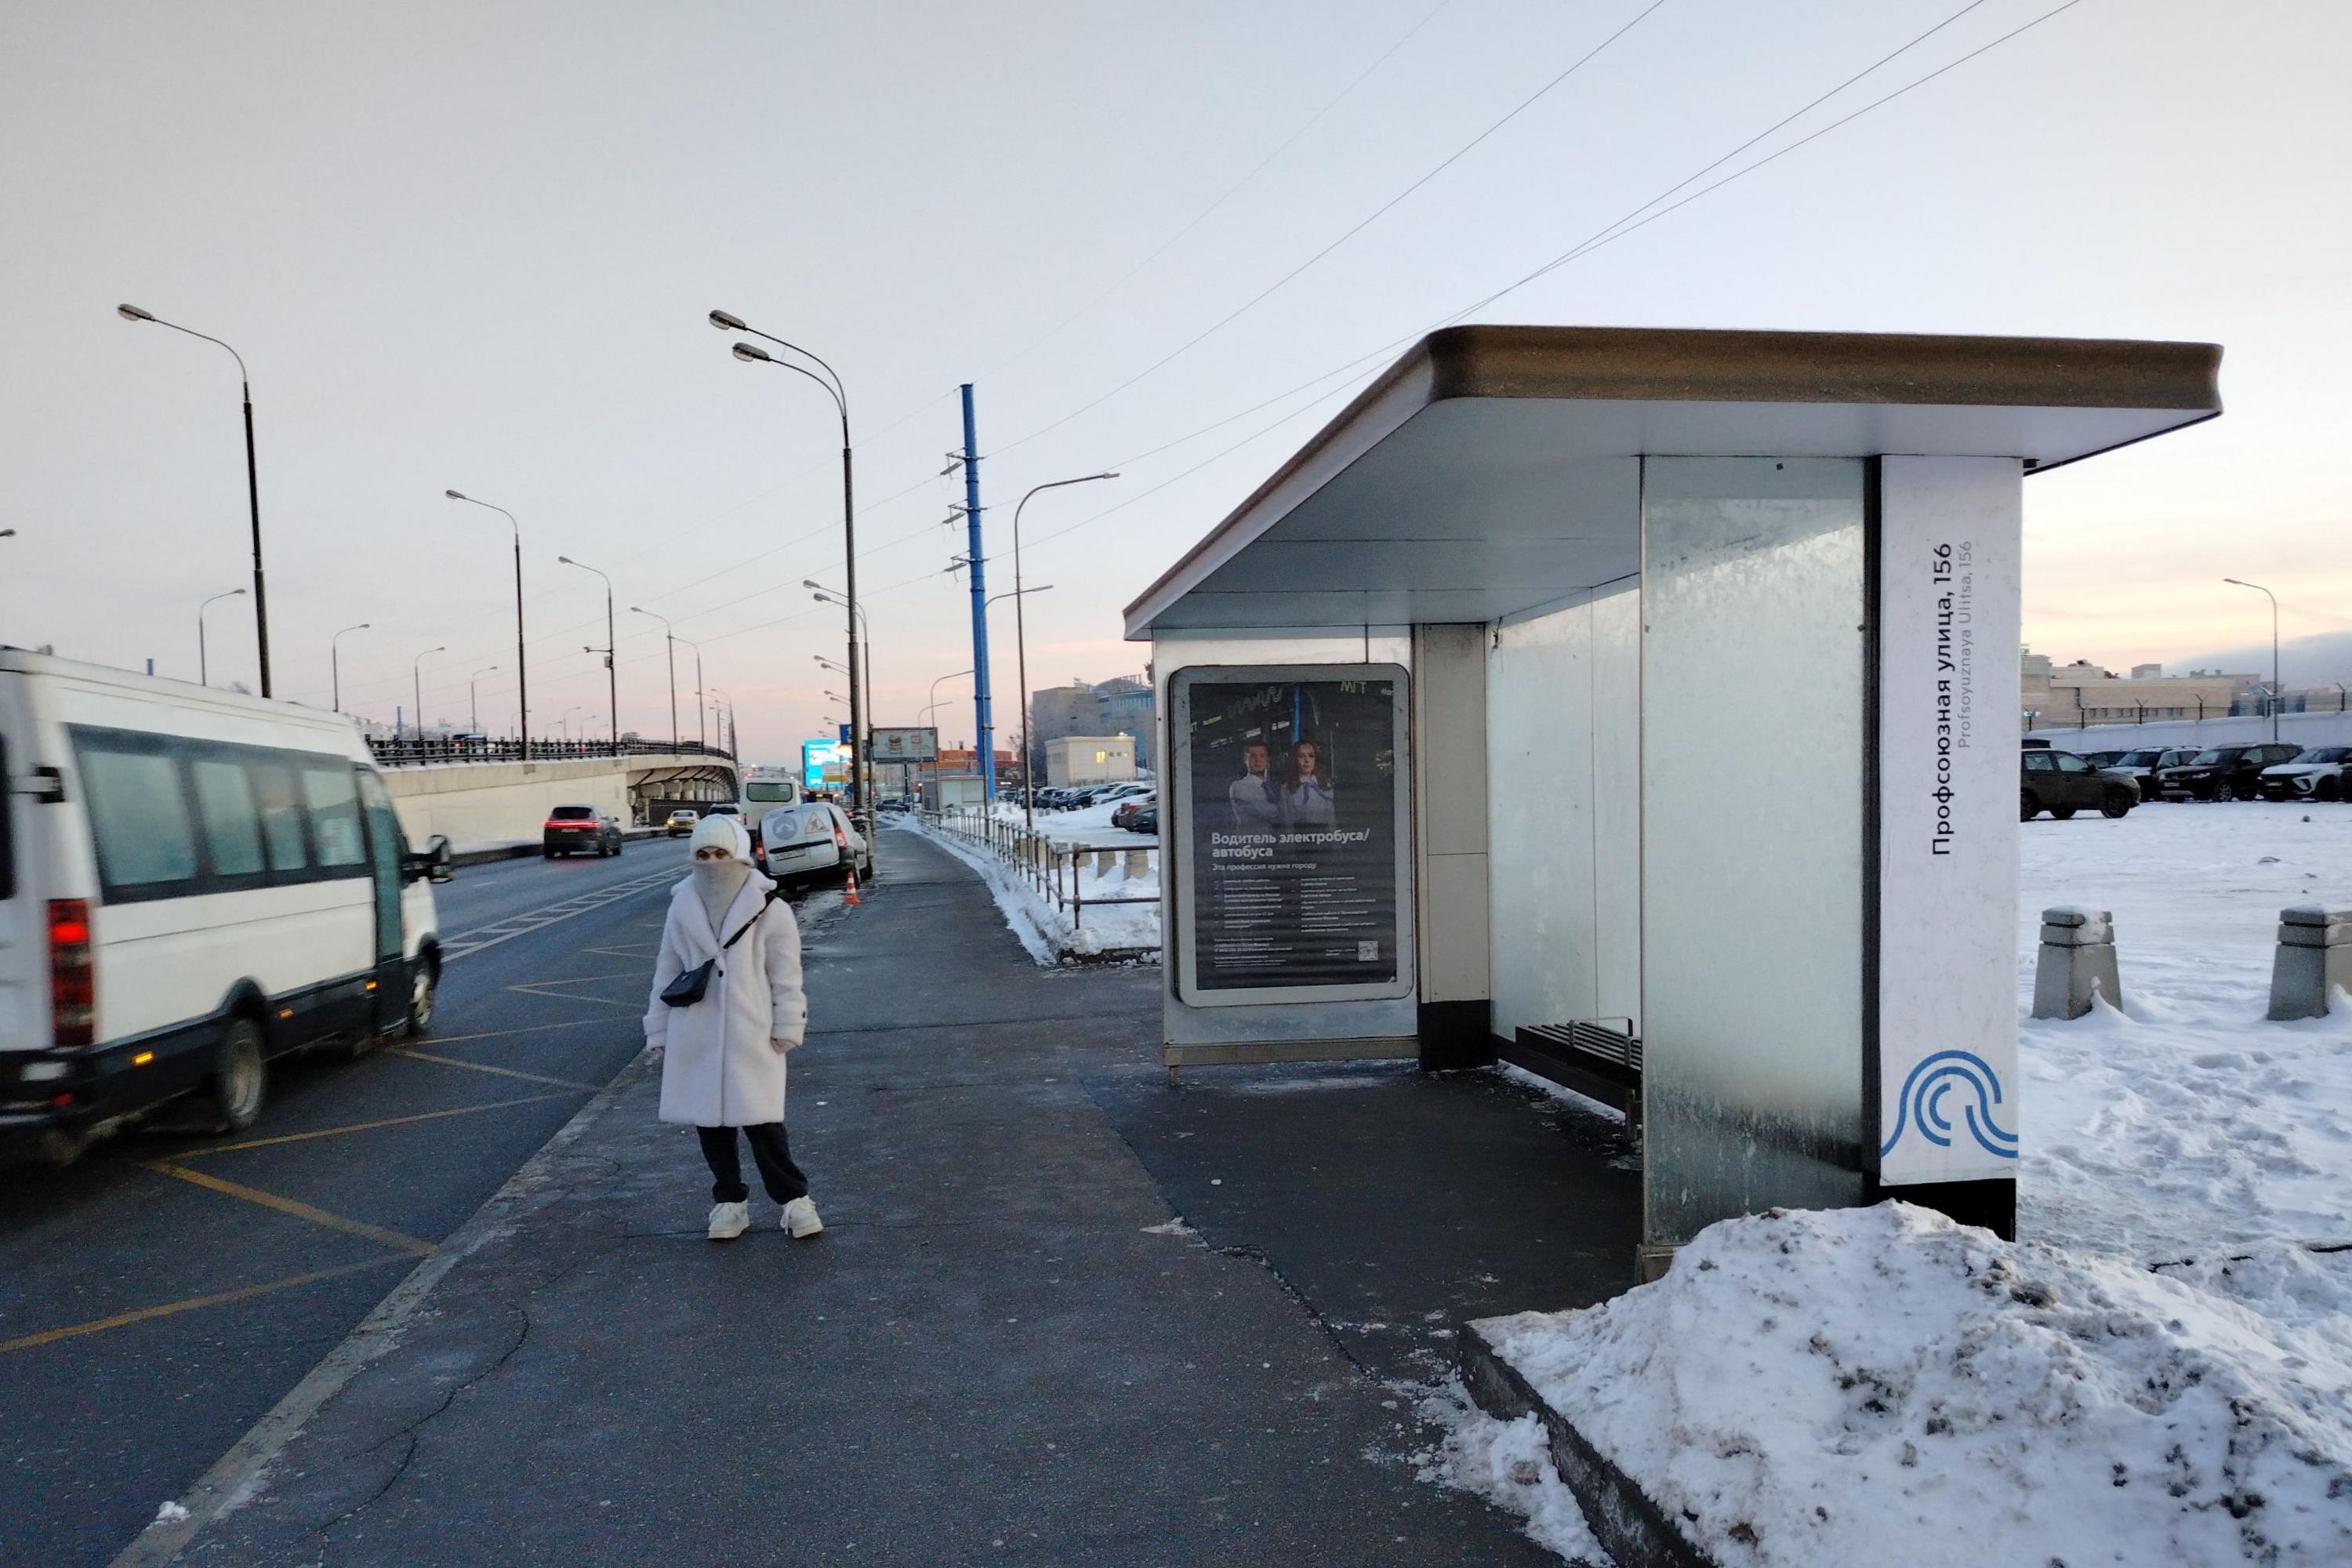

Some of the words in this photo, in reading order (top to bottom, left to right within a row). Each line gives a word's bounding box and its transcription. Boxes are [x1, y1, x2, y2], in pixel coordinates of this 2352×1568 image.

[1933, 543, 1951, 584] 156
[1958, 541, 1971, 568] 156
[1958, 572, 1973, 624] Ulitsa,
[1936, 591, 1955, 672] улица,
[1958, 630, 1973, 748] Profsoyuznaya
[1932, 680, 1955, 855] Профсоюзная
[1211, 832, 1276, 846] Водитель
[1279, 828, 1370, 844] электробуса/
[1212, 845, 1273, 859] автобуса
[1226, 862, 1266, 871] профессия
